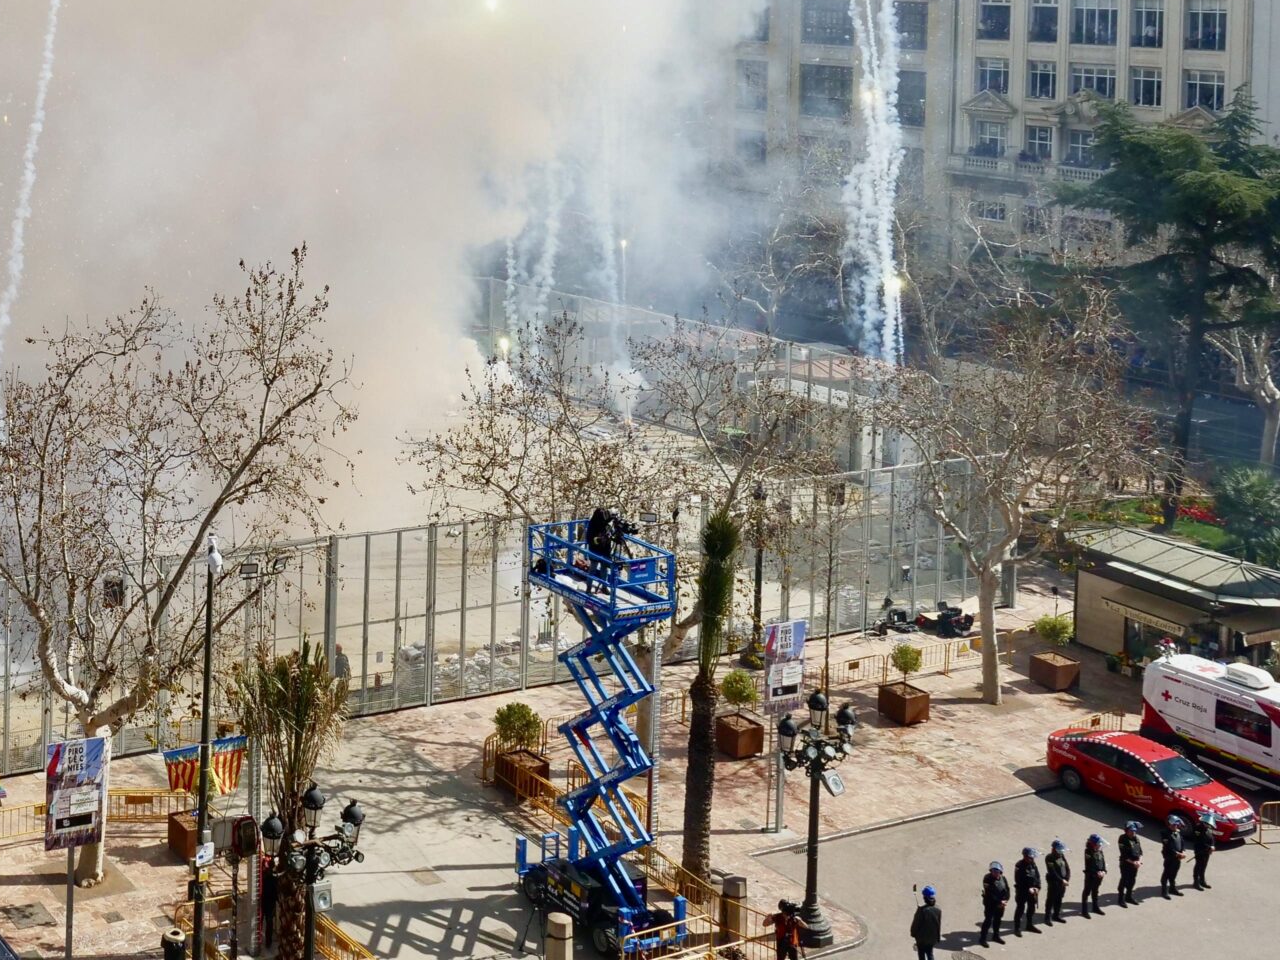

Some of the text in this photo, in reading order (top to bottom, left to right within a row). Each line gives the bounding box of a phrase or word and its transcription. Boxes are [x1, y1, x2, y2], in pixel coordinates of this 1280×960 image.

[1174, 696, 1208, 714] Cruz Roja
[68, 746, 84, 757] PIRO
[67, 763, 84, 773] NIES
